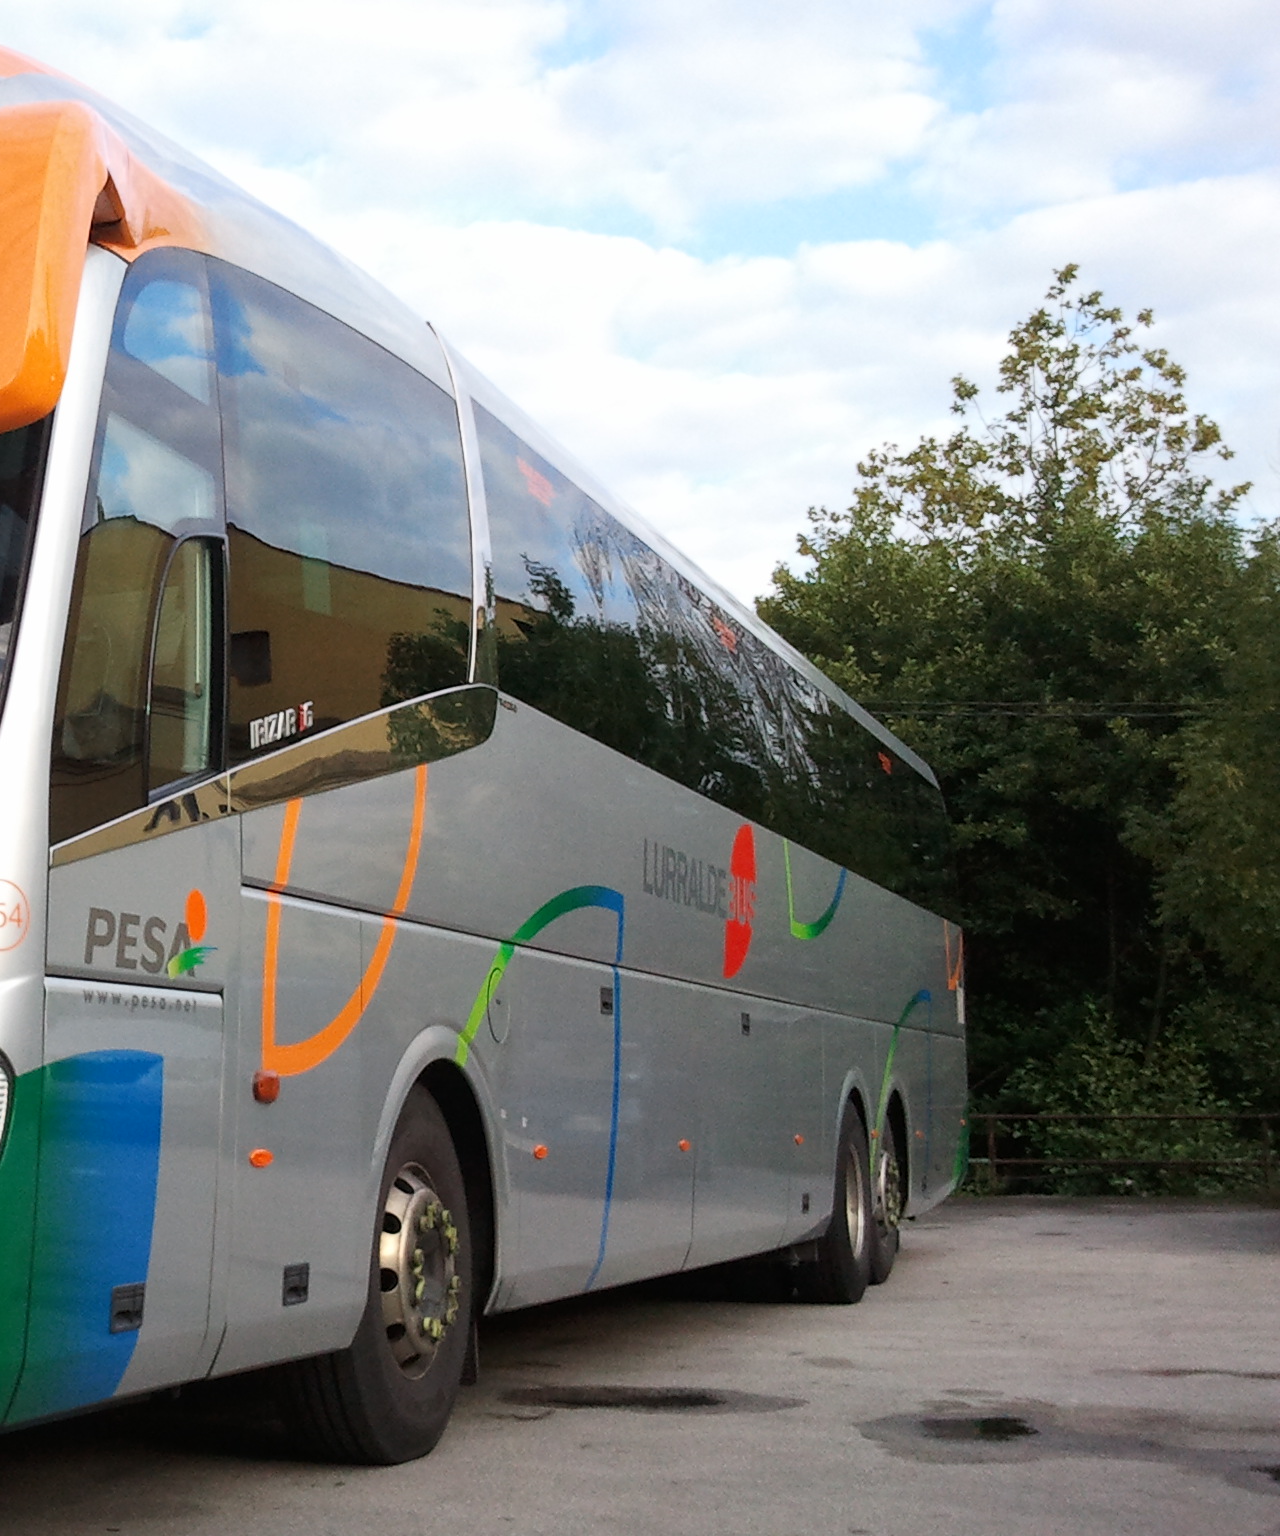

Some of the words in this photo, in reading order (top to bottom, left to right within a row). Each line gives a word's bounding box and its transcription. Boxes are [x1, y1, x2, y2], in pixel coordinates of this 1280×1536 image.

[250, 707, 297, 749] IRIZAR
[83, 906, 196, 977] PESA
[83, 989, 197, 1013] www.pesa.net
